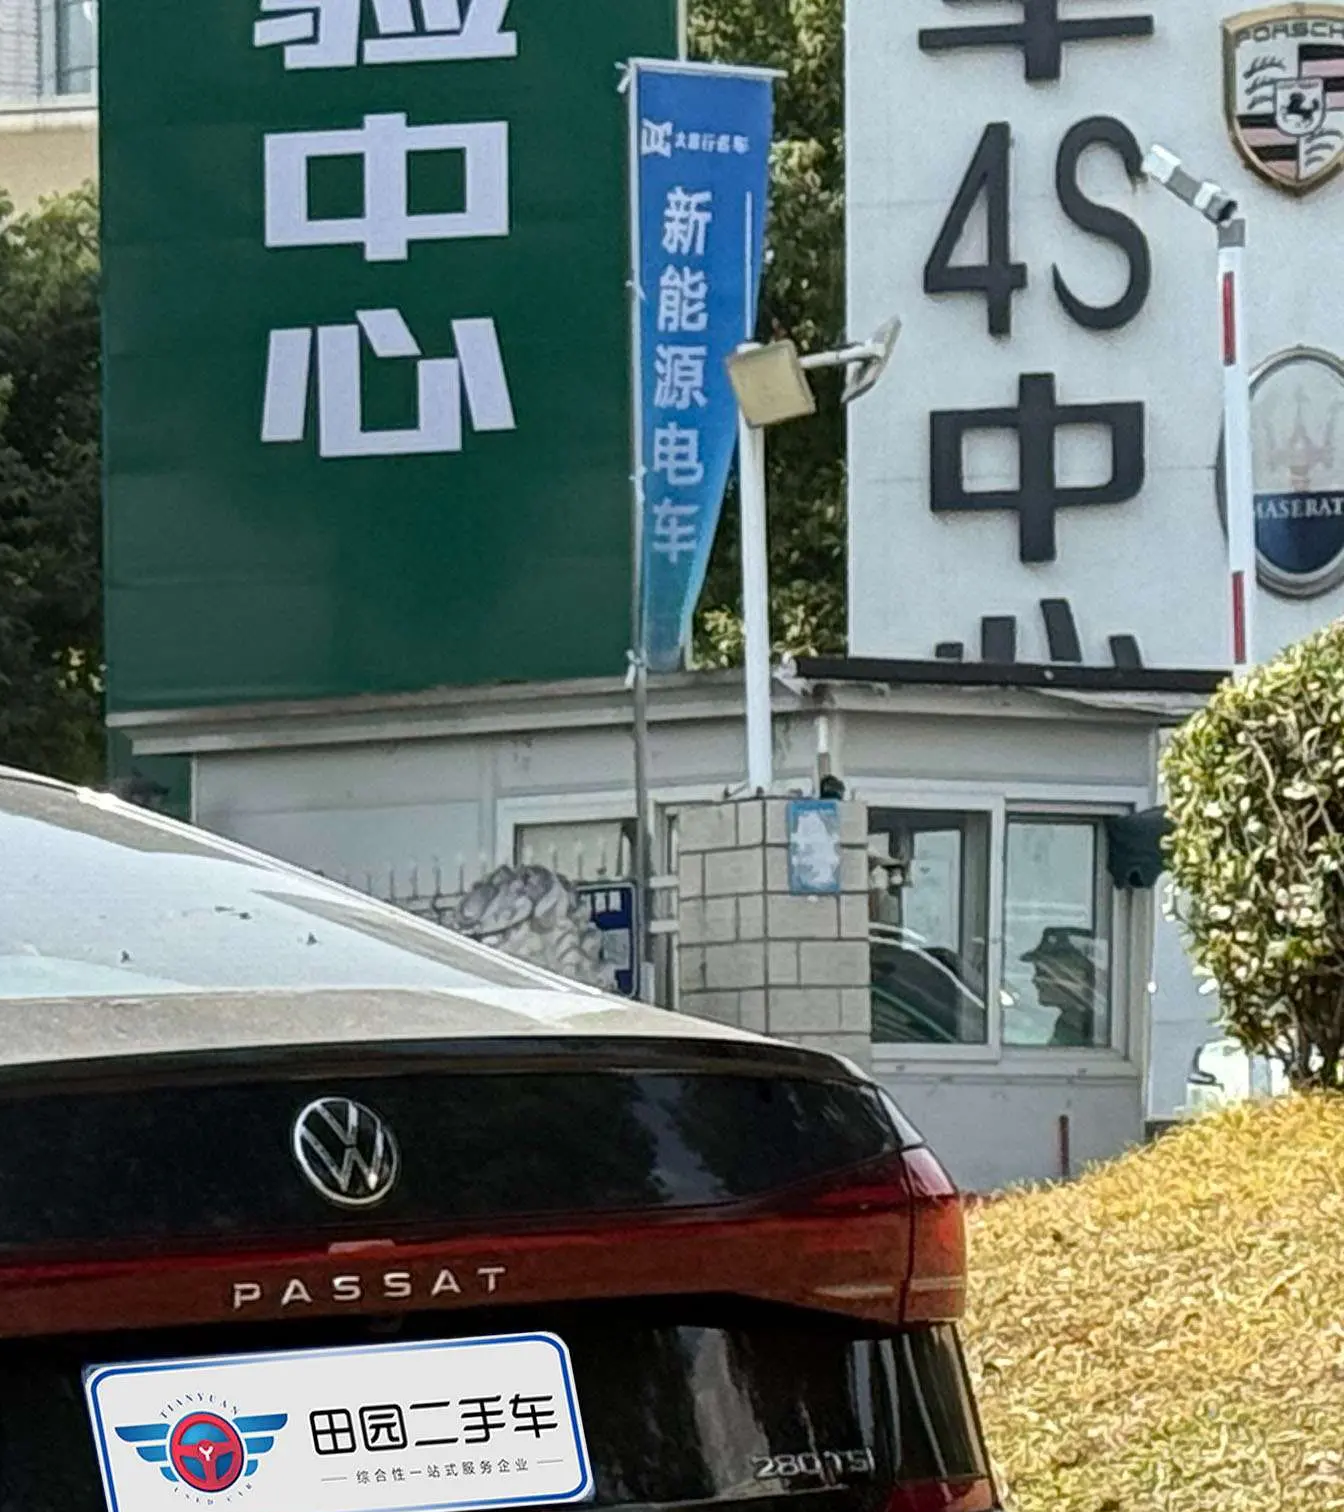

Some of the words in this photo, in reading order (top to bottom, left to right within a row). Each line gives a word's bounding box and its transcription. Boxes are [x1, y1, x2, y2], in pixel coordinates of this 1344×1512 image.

[652, 186, 712, 564] 新能源电车
[1255, 497, 1344, 519] ASERAT
[232, 1266, 506, 1310] PASSAT
[308, 1392, 559, 1456] 田园二手车
[355, 1457, 530, 1485] 综合性一站式服务企业
